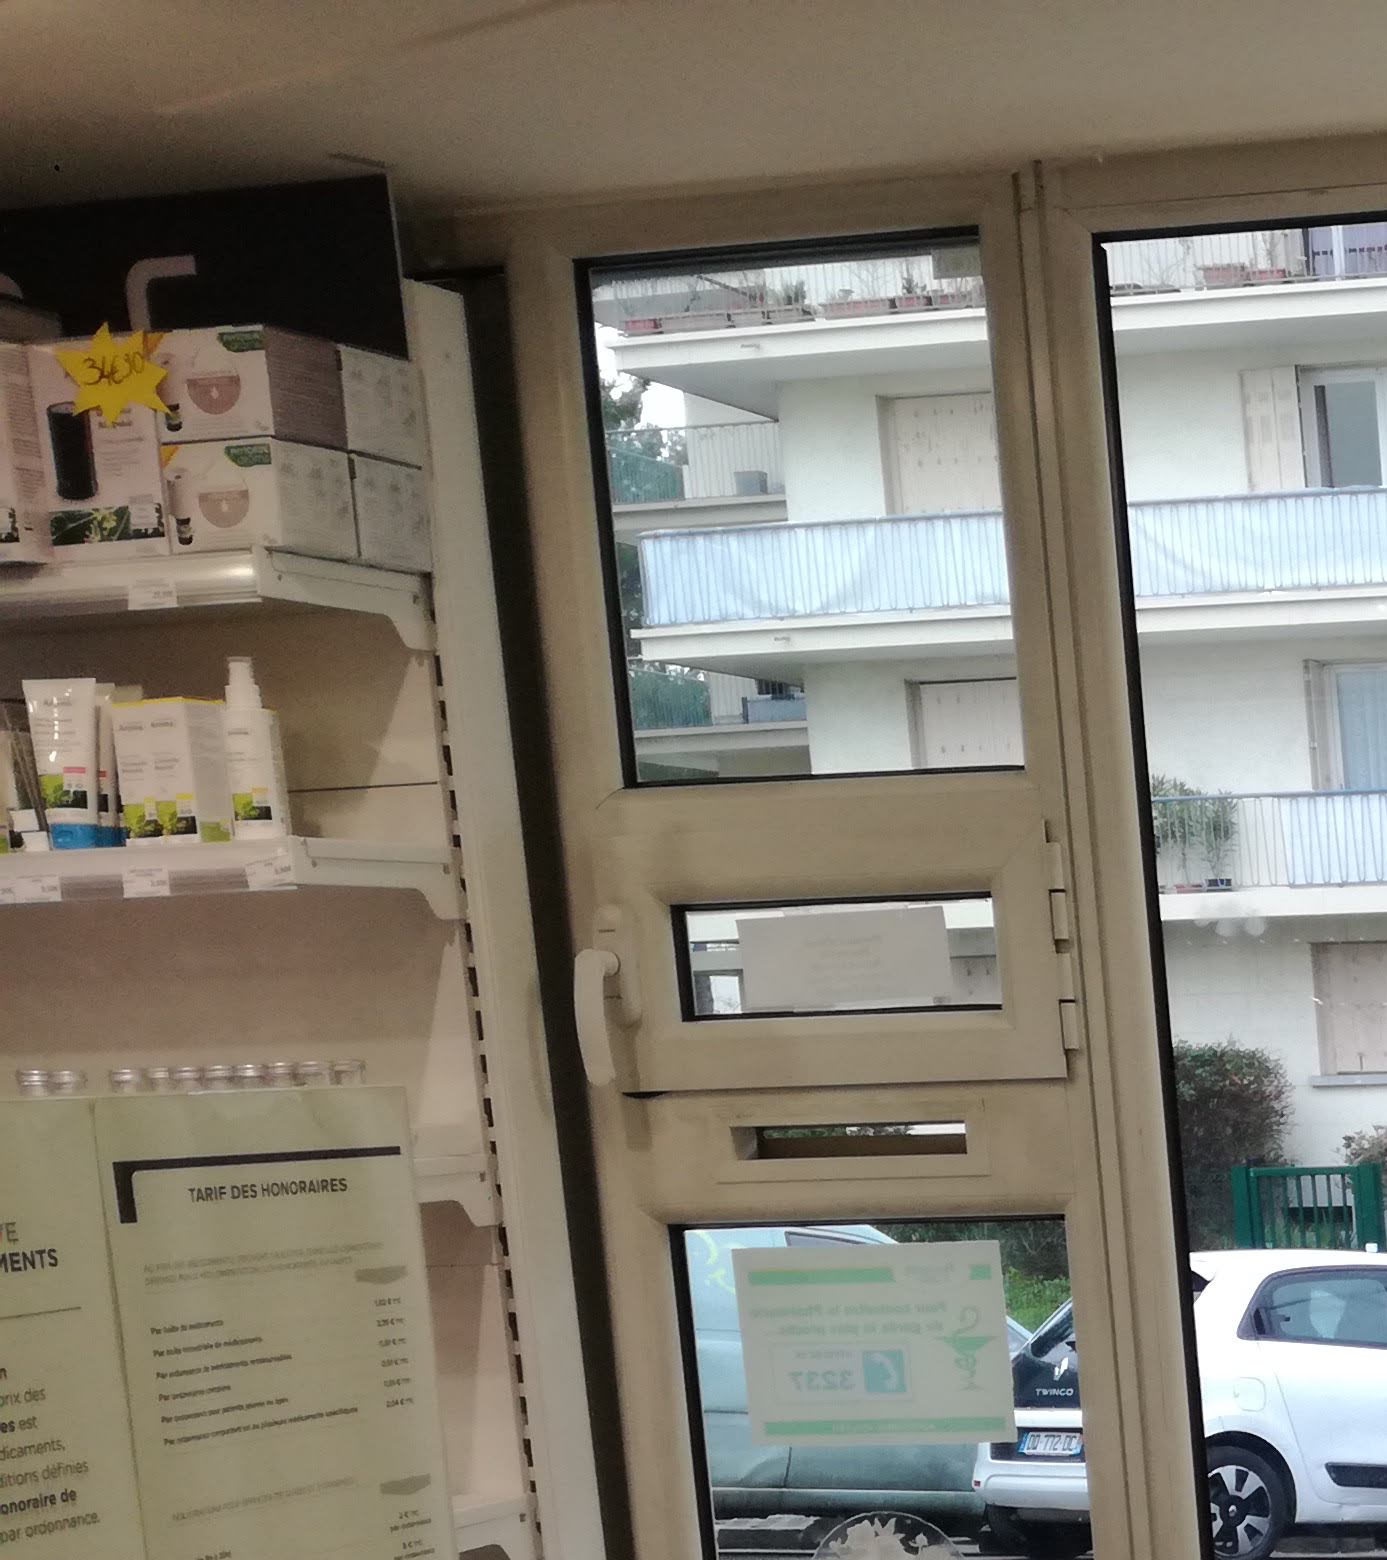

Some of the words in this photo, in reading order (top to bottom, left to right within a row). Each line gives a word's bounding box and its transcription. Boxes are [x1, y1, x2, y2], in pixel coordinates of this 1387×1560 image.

[188, 1185, 227, 1203] TARIF
[230, 1182, 258, 1200] DES
[261, 1177, 348, 1199] HONORAIRES
[60, 1489, 77, 1504] de
